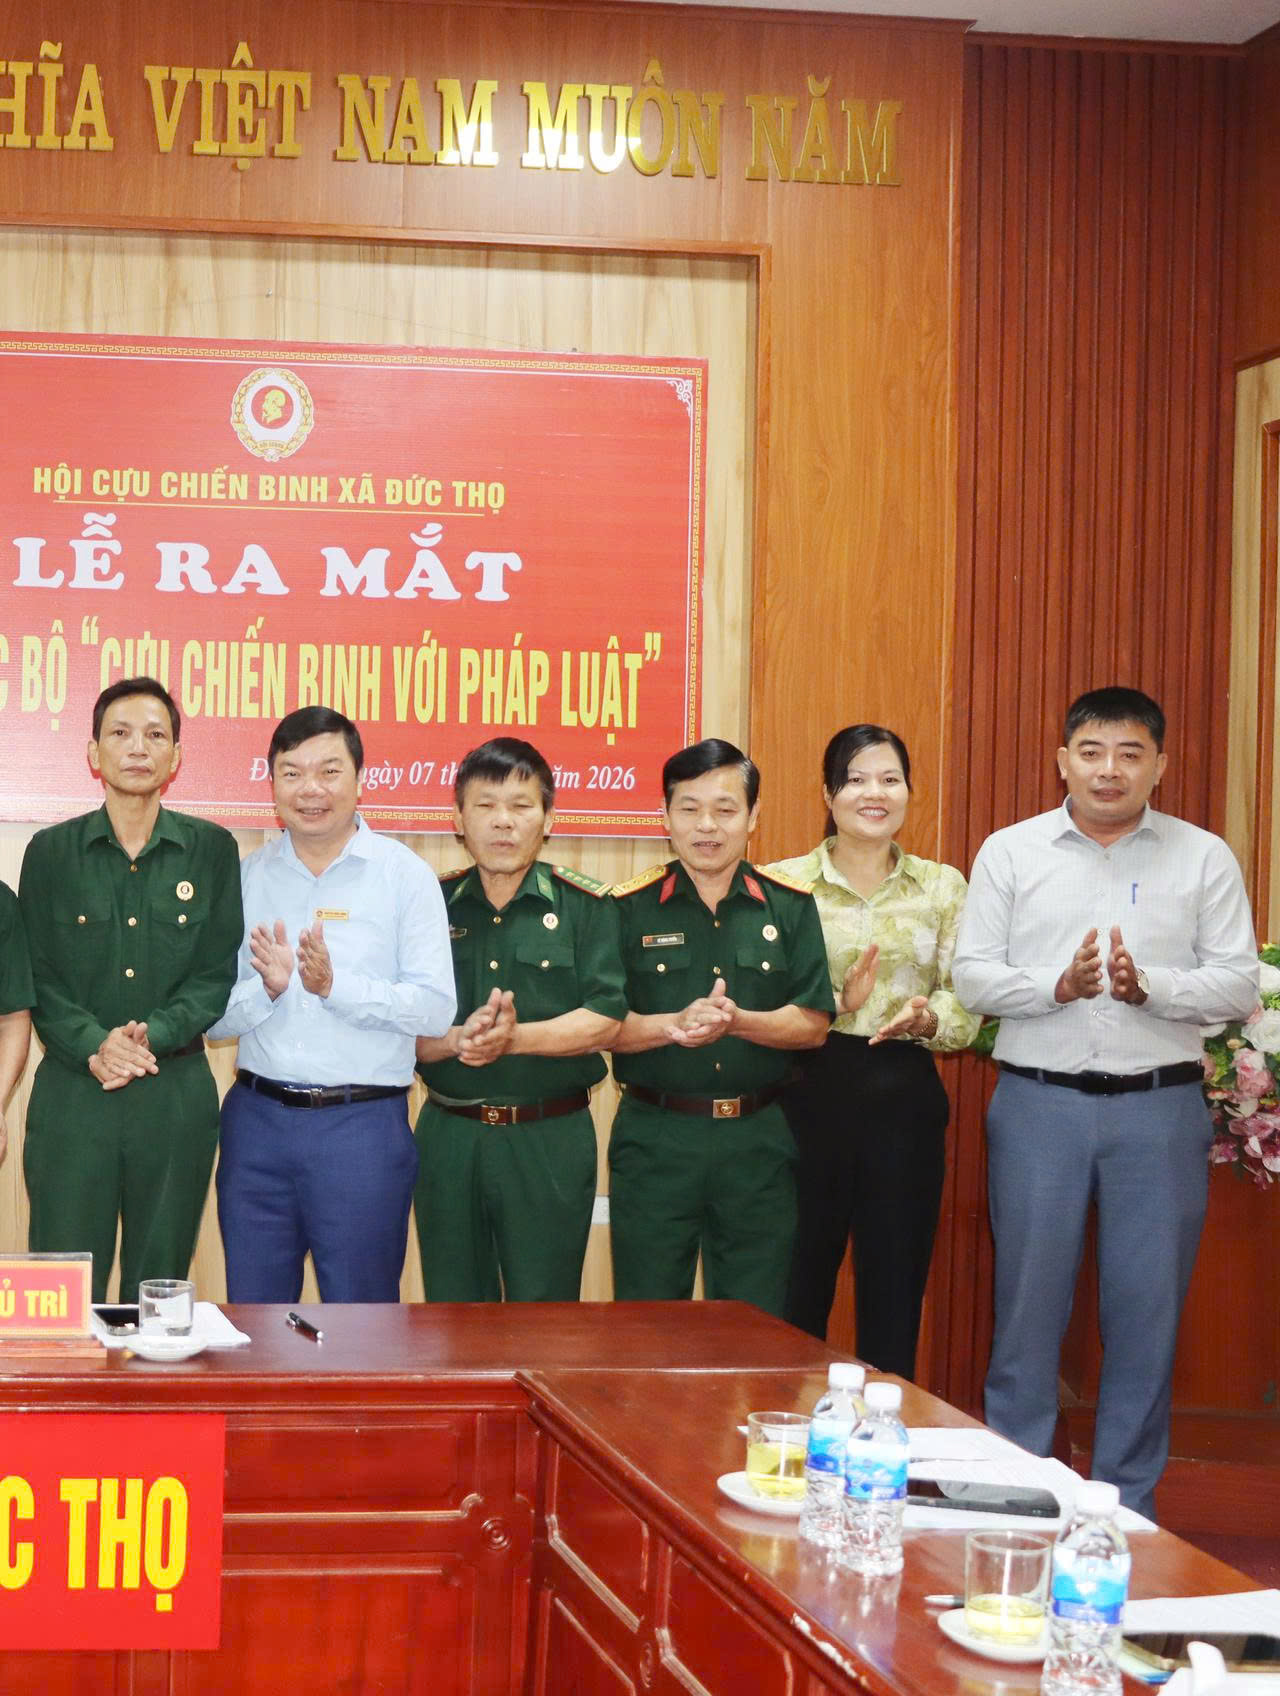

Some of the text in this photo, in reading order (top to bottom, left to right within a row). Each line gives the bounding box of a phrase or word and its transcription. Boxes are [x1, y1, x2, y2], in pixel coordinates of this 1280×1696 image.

[144, 41, 312, 170] VIỆT
[335, 73, 500, 167] NAM
[521, 59, 724, 178] MUÔN
[745, 75, 902, 186] NĂM
[33, 462, 506, 515] HỘI CỰU CHIẾN BINH XÃ ĐỨC THỌ
[12, 512, 522, 602] LỄ RA MẮT
[21, 619, 68, 731] BỘ
[180, 616, 287, 720] CHIẾN
[298, 643, 381, 721] BINH
[393, 630, 447, 724] VỚI
[459, 633, 550, 726] PHÁP
[409, 761, 435, 785] 07
[552, 764, 580, 790] ăm
[586, 765, 636, 790] 2026
[24, 1284, 68, 1318] TRÌ
[59, 1476, 189, 1612] THỌ
